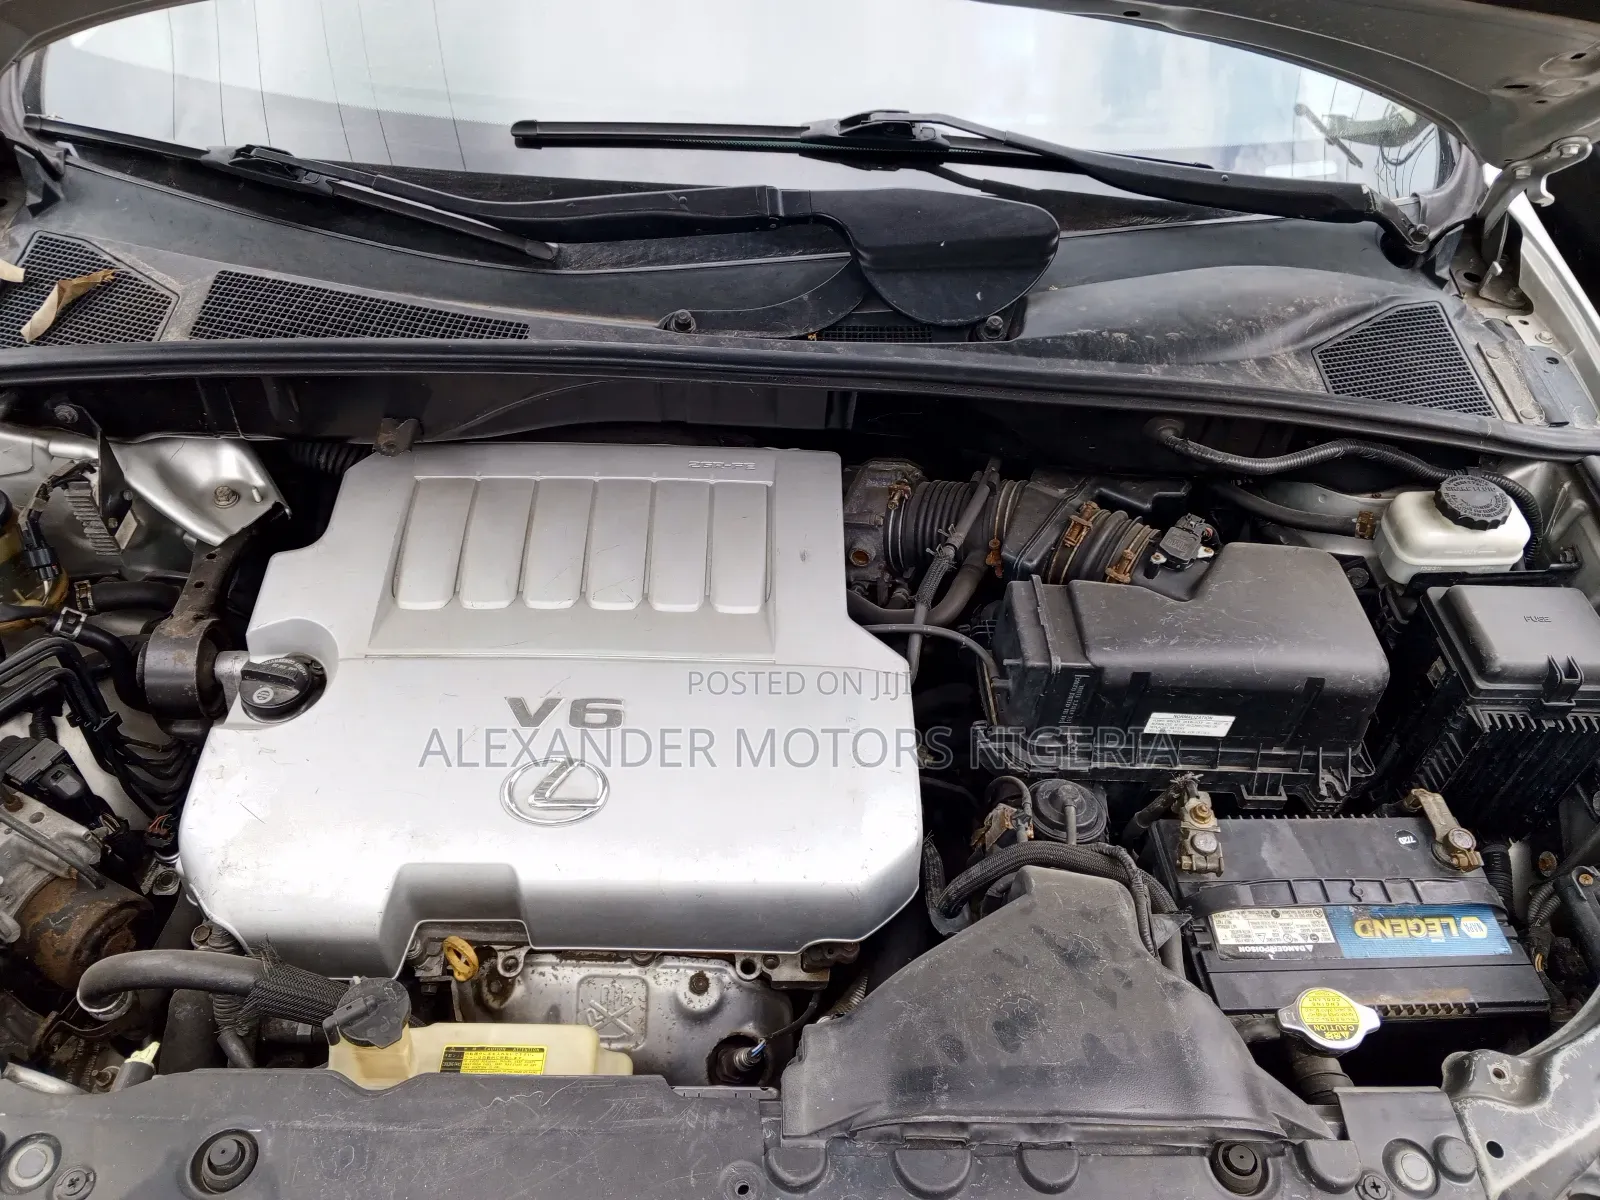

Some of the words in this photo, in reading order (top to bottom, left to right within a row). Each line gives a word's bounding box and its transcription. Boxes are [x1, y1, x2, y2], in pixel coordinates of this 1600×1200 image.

[1523, 615, 1552, 623] FUSE
[503, 696, 626, 729] V6
[1354, 916, 1460, 938] LEGEND
[1462, 922, 1485, 933] NAPA
